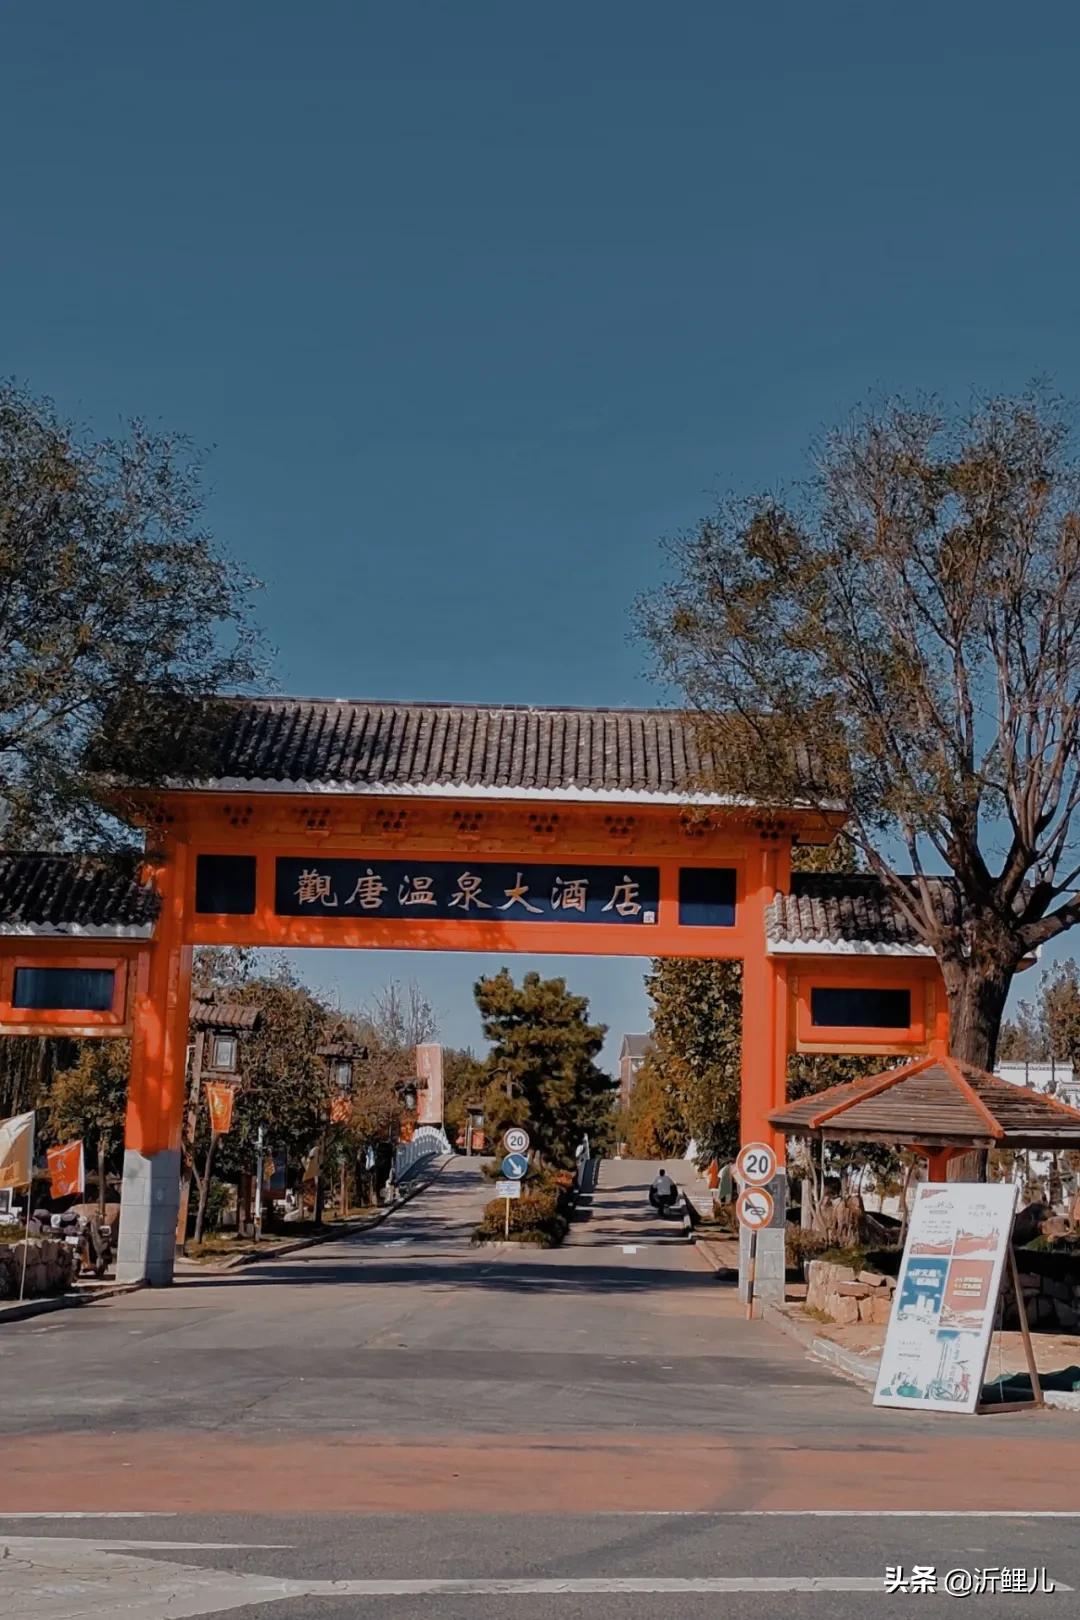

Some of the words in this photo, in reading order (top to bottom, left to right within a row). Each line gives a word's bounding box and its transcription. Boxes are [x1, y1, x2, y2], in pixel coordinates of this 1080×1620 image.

[294, 868, 643, 917] 觀唐温泉大酒店
[510, 1136, 524, 1146] 20
[746, 1154, 769, 1174] 20
